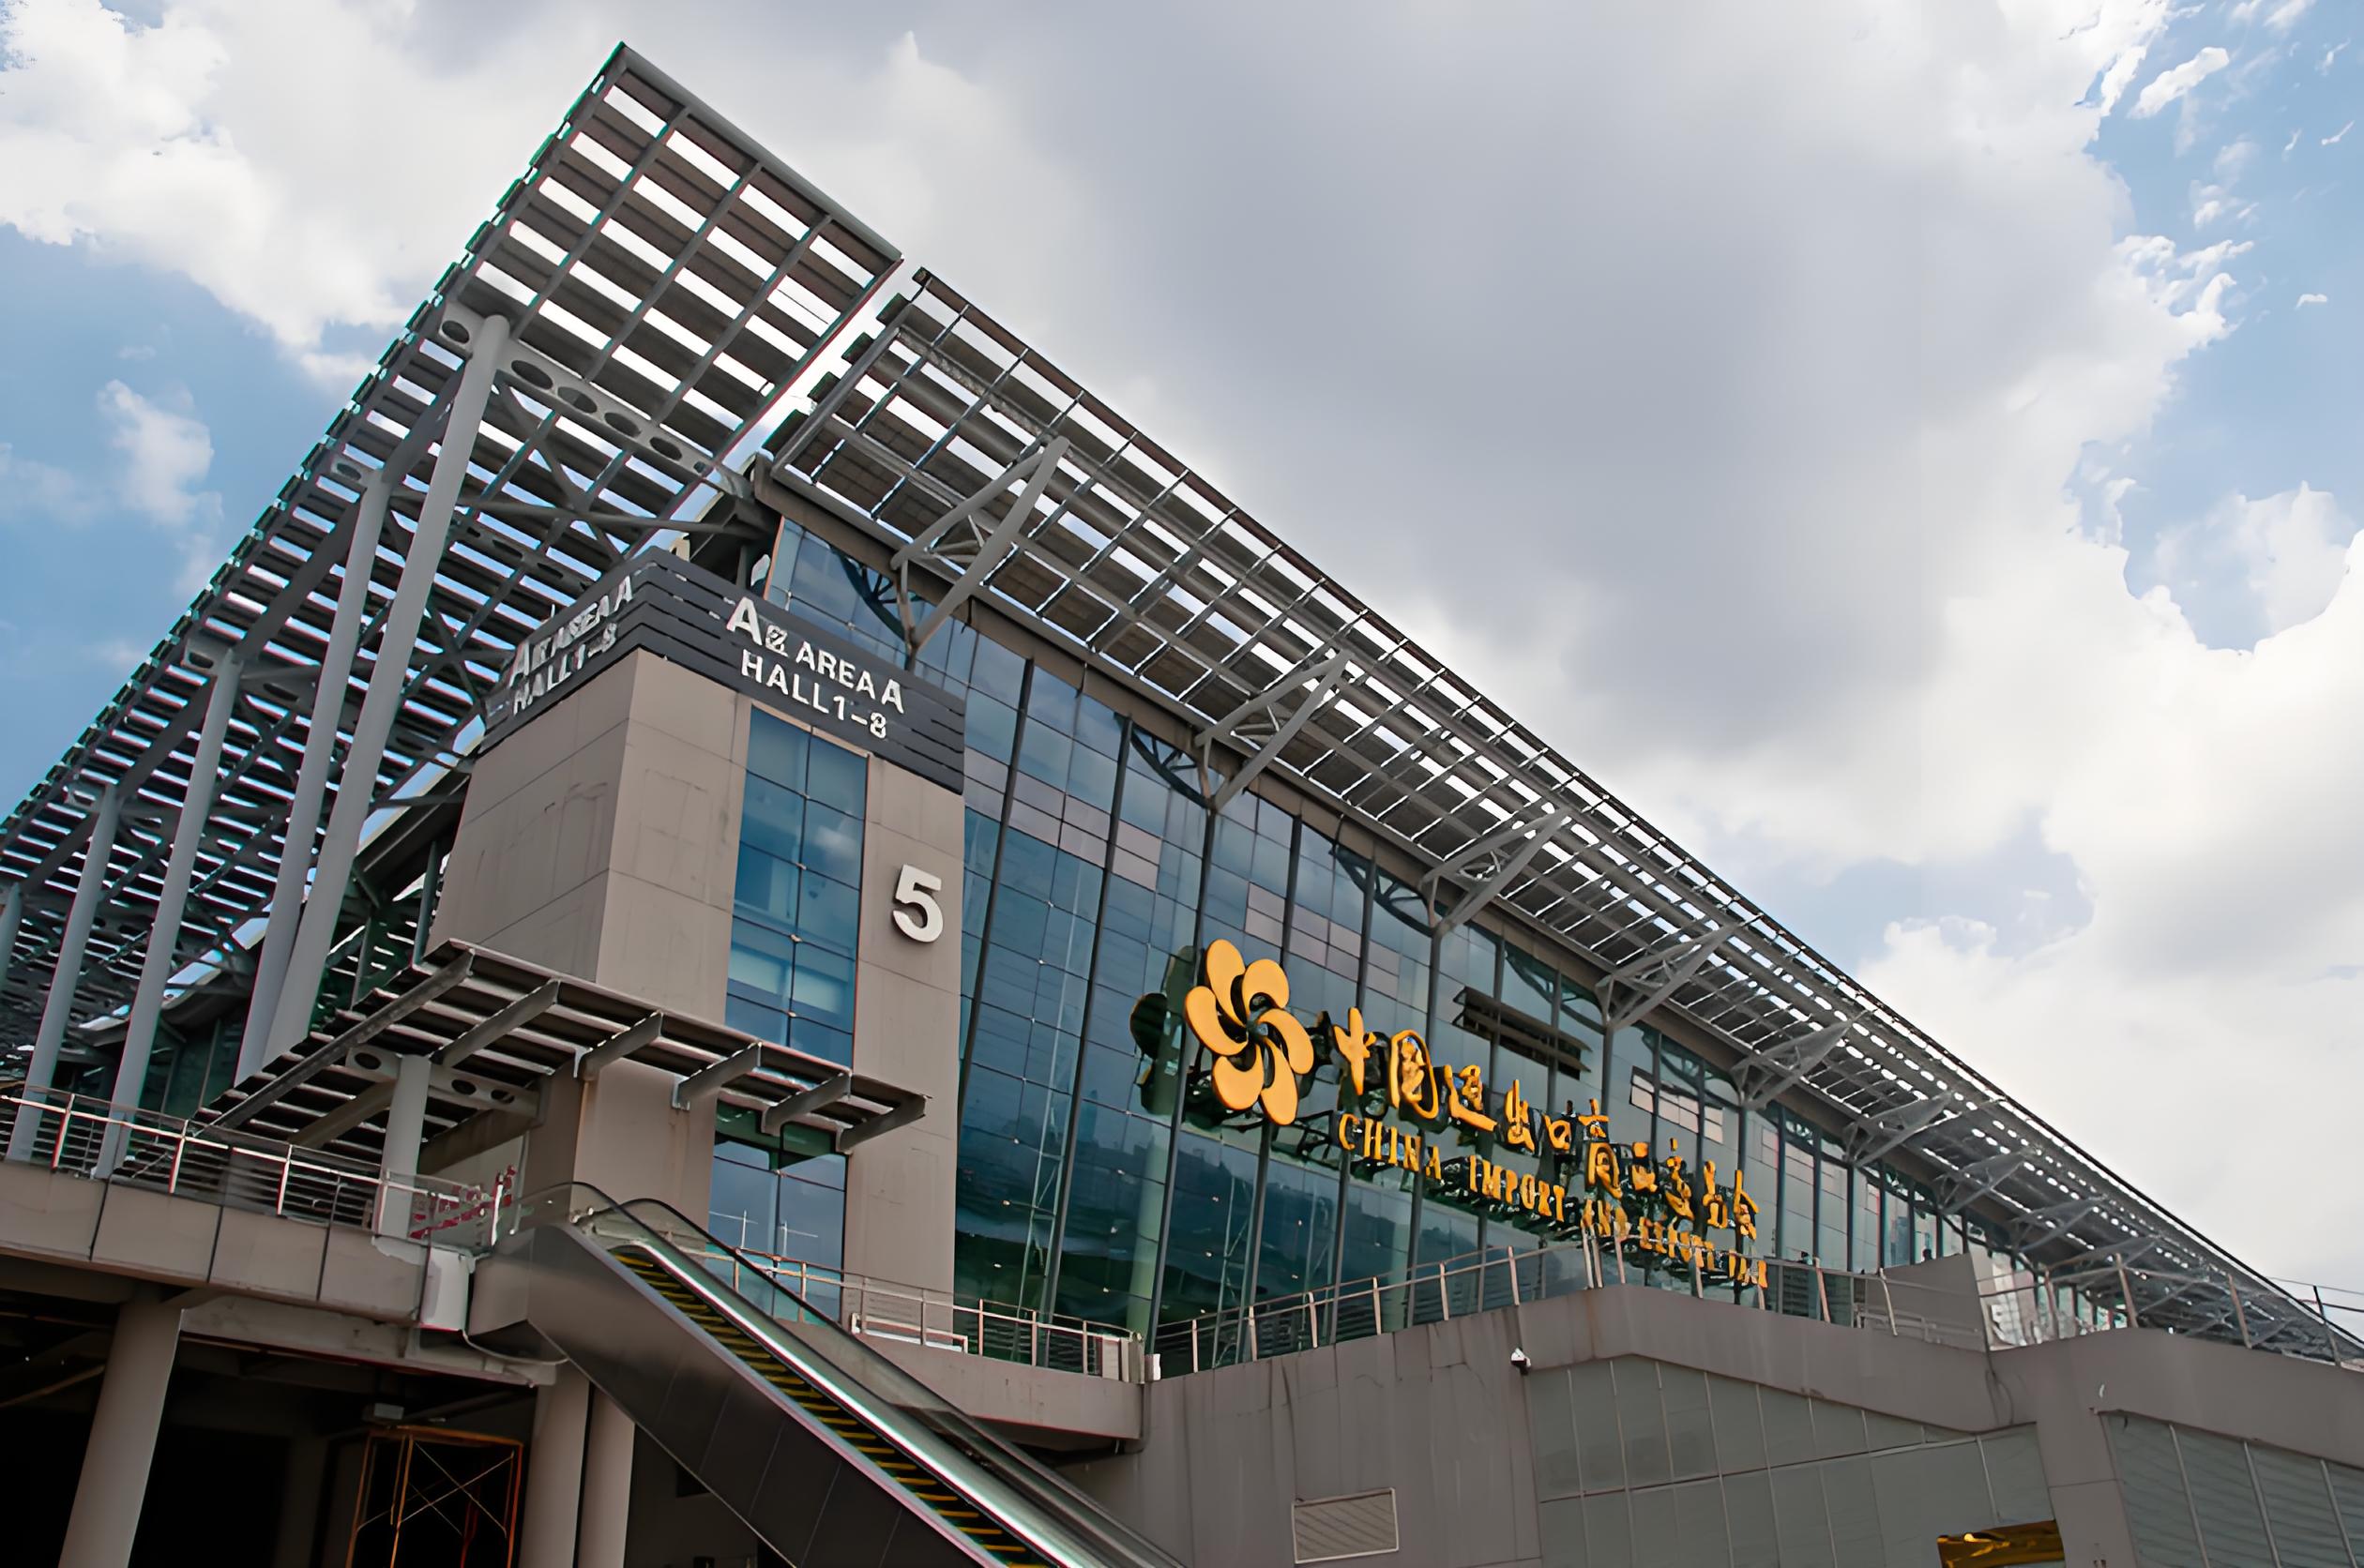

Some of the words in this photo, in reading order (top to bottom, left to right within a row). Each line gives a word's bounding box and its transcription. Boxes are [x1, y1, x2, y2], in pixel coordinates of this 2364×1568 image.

[796, 641, 876, 700] AREA
[881, 678, 914, 714] A
[892, 864, 944, 942] 5
[1338, 1112, 1442, 1181] CHINA
[1469, 1154, 1566, 1223] IMPORT
